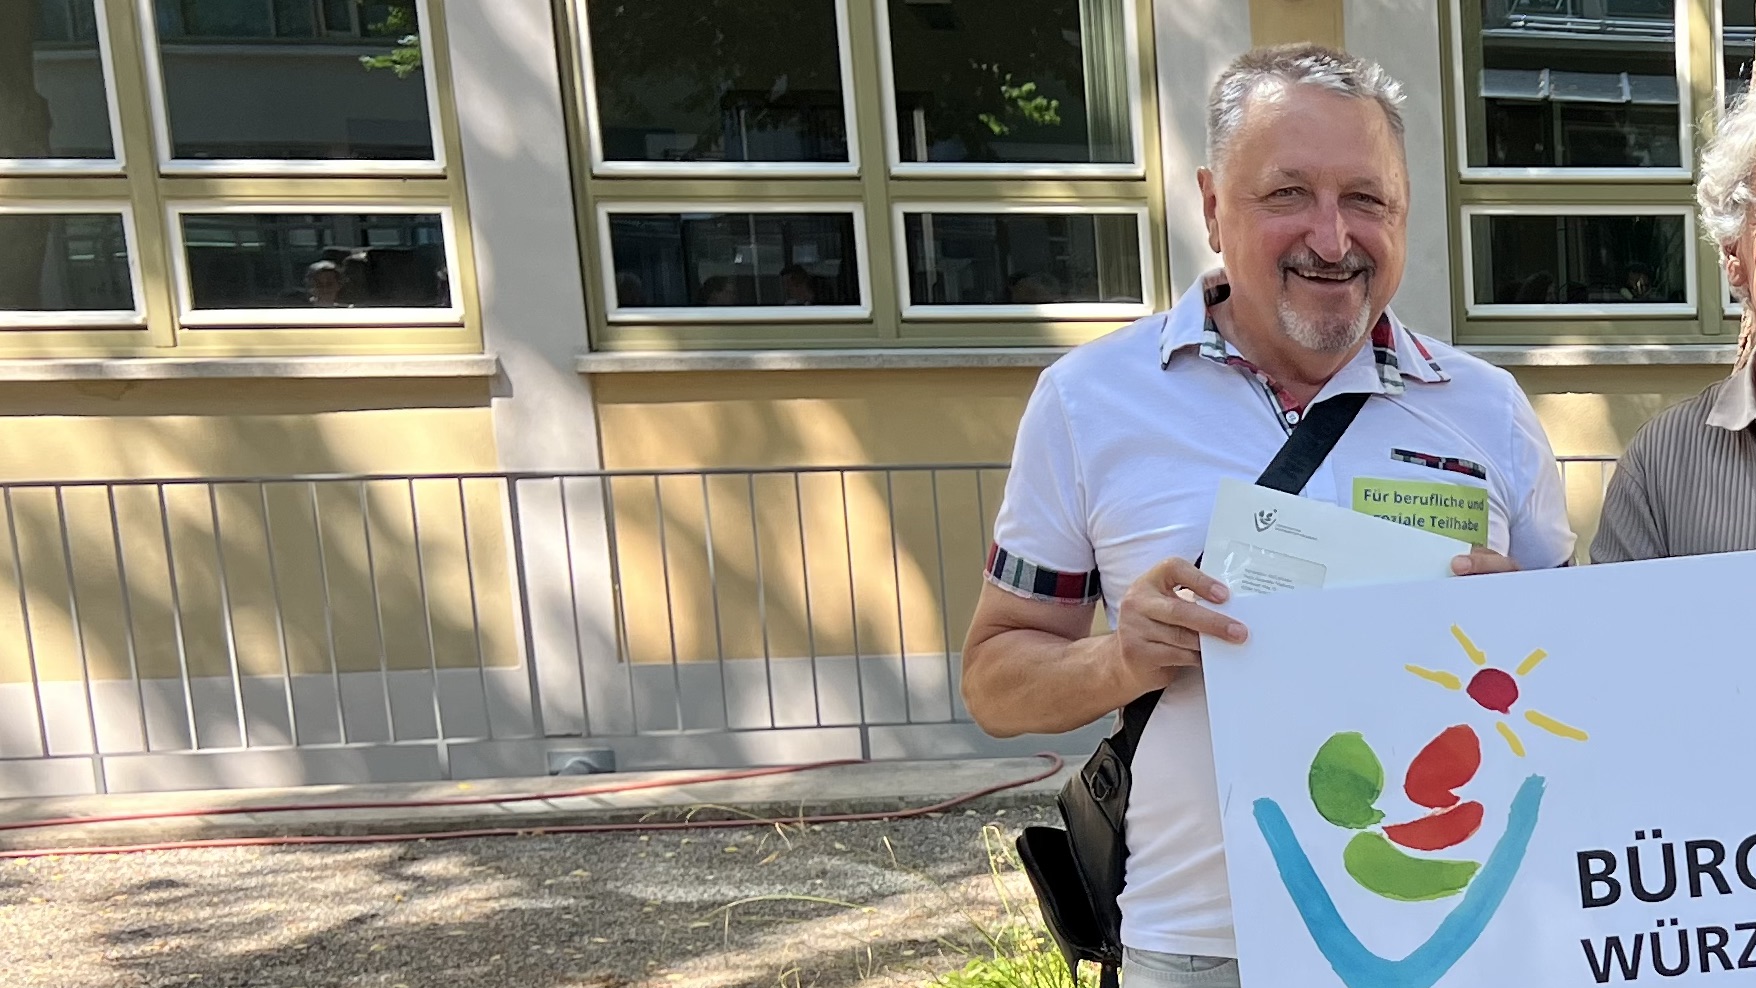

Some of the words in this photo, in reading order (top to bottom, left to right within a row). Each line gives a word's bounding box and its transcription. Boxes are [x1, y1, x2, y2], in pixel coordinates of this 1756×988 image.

[1363, 487, 1389, 502] Für
[1393, 491, 1465, 509] berufliche
[1467, 498, 1484, 511] und
[1373, 512, 1425, 527] ziale
[1429, 515, 1479, 531] Teilhabe
